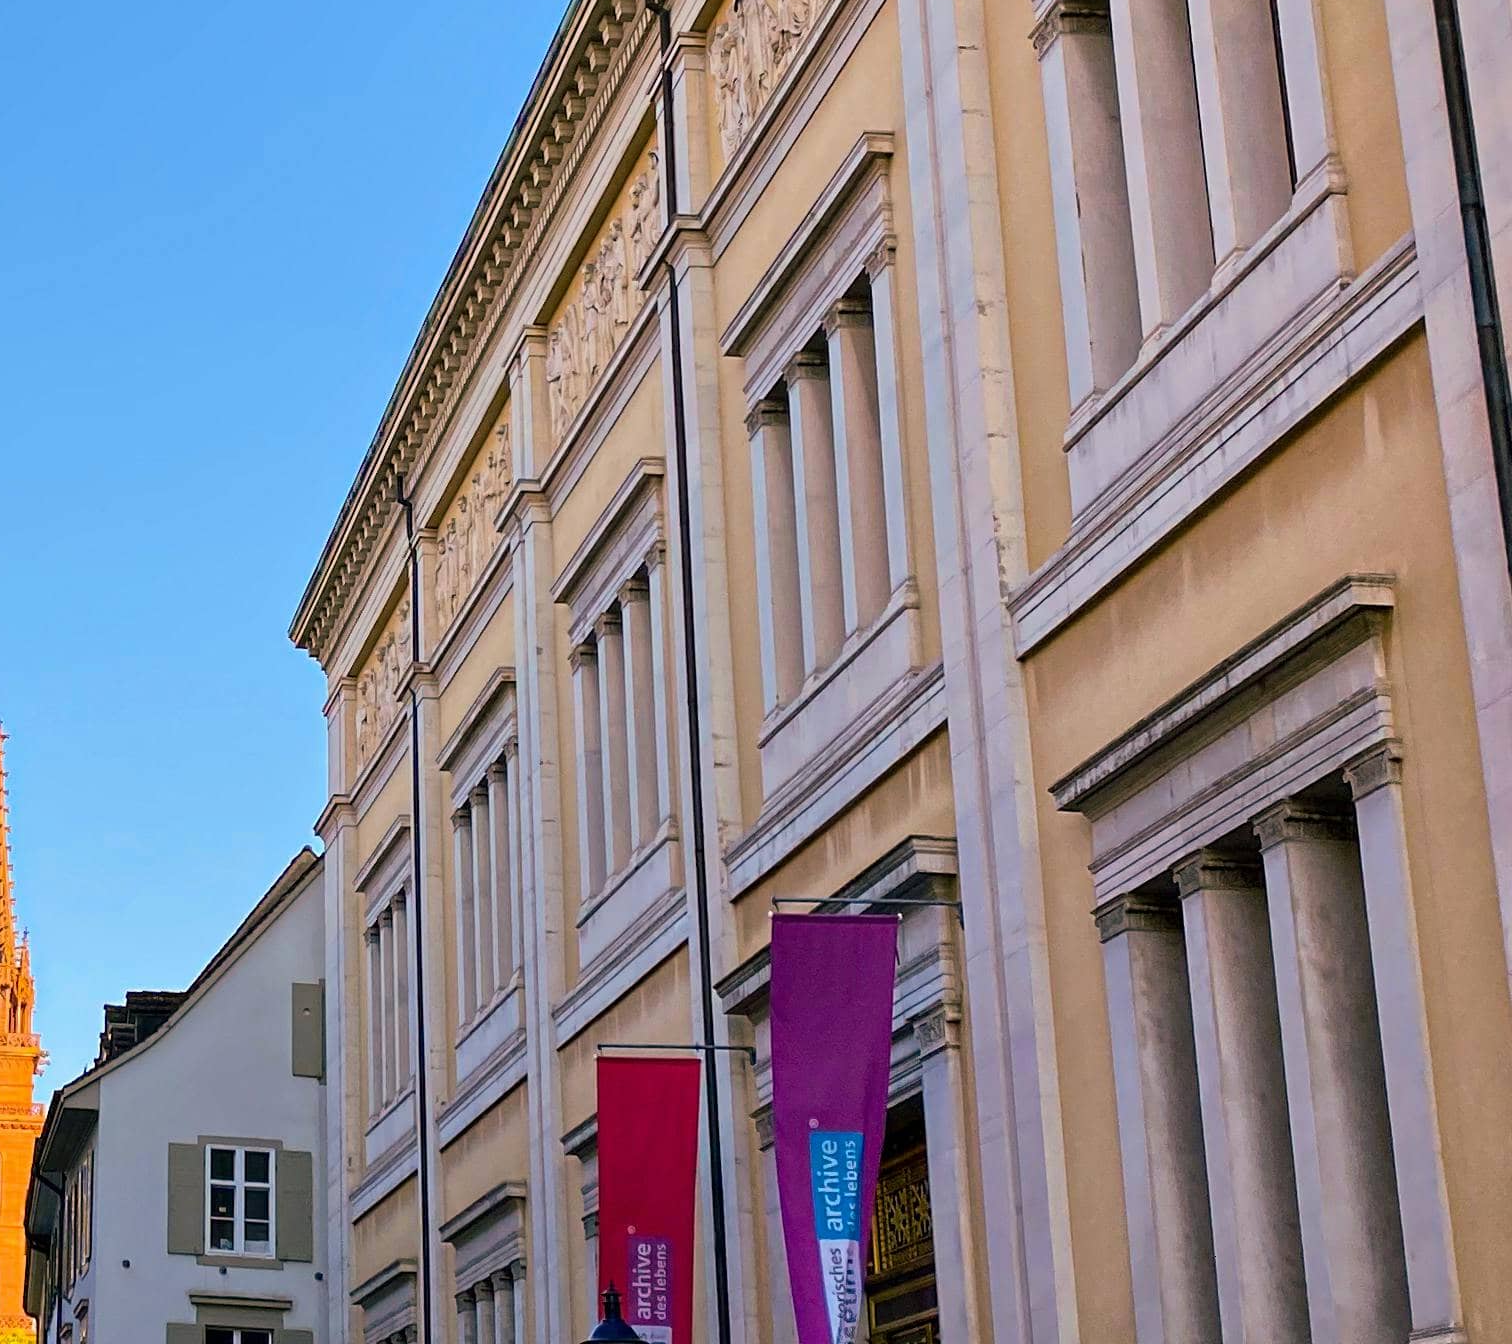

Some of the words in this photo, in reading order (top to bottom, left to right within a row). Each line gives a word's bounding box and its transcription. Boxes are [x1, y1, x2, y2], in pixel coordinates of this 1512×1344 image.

[817, 1140, 843, 1232] archive
[843, 1140, 858, 1197] lebens
[632, 1243, 651, 1320] archive
[654, 1243, 667, 1291] lebens
[654, 1295, 667, 1321] des
